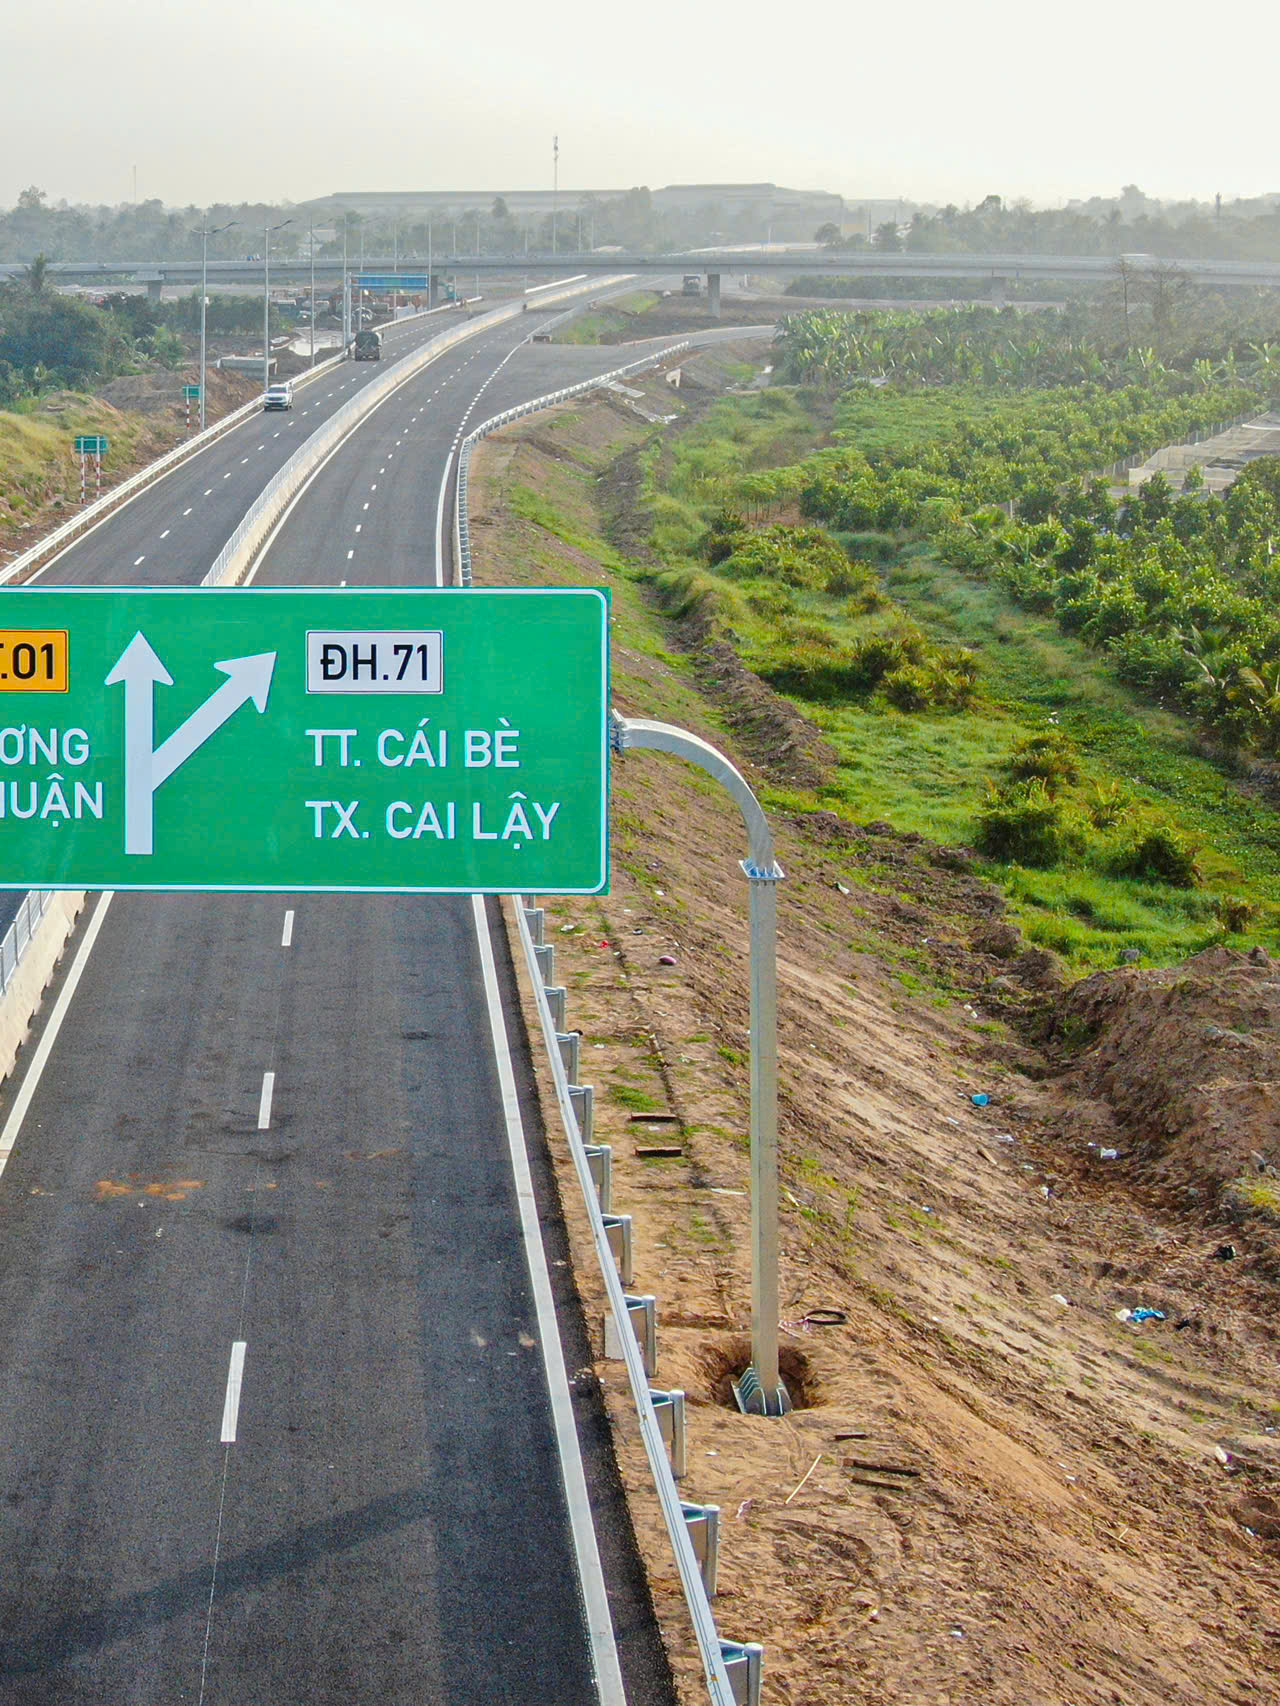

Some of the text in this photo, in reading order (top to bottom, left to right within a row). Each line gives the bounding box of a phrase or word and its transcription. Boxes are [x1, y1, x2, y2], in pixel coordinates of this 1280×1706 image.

[320, 644, 428, 681] ĐH.71
[306, 717, 520, 768] TT. CÁI BÈ
[306, 791, 560, 849] TX. CAI LẬY
